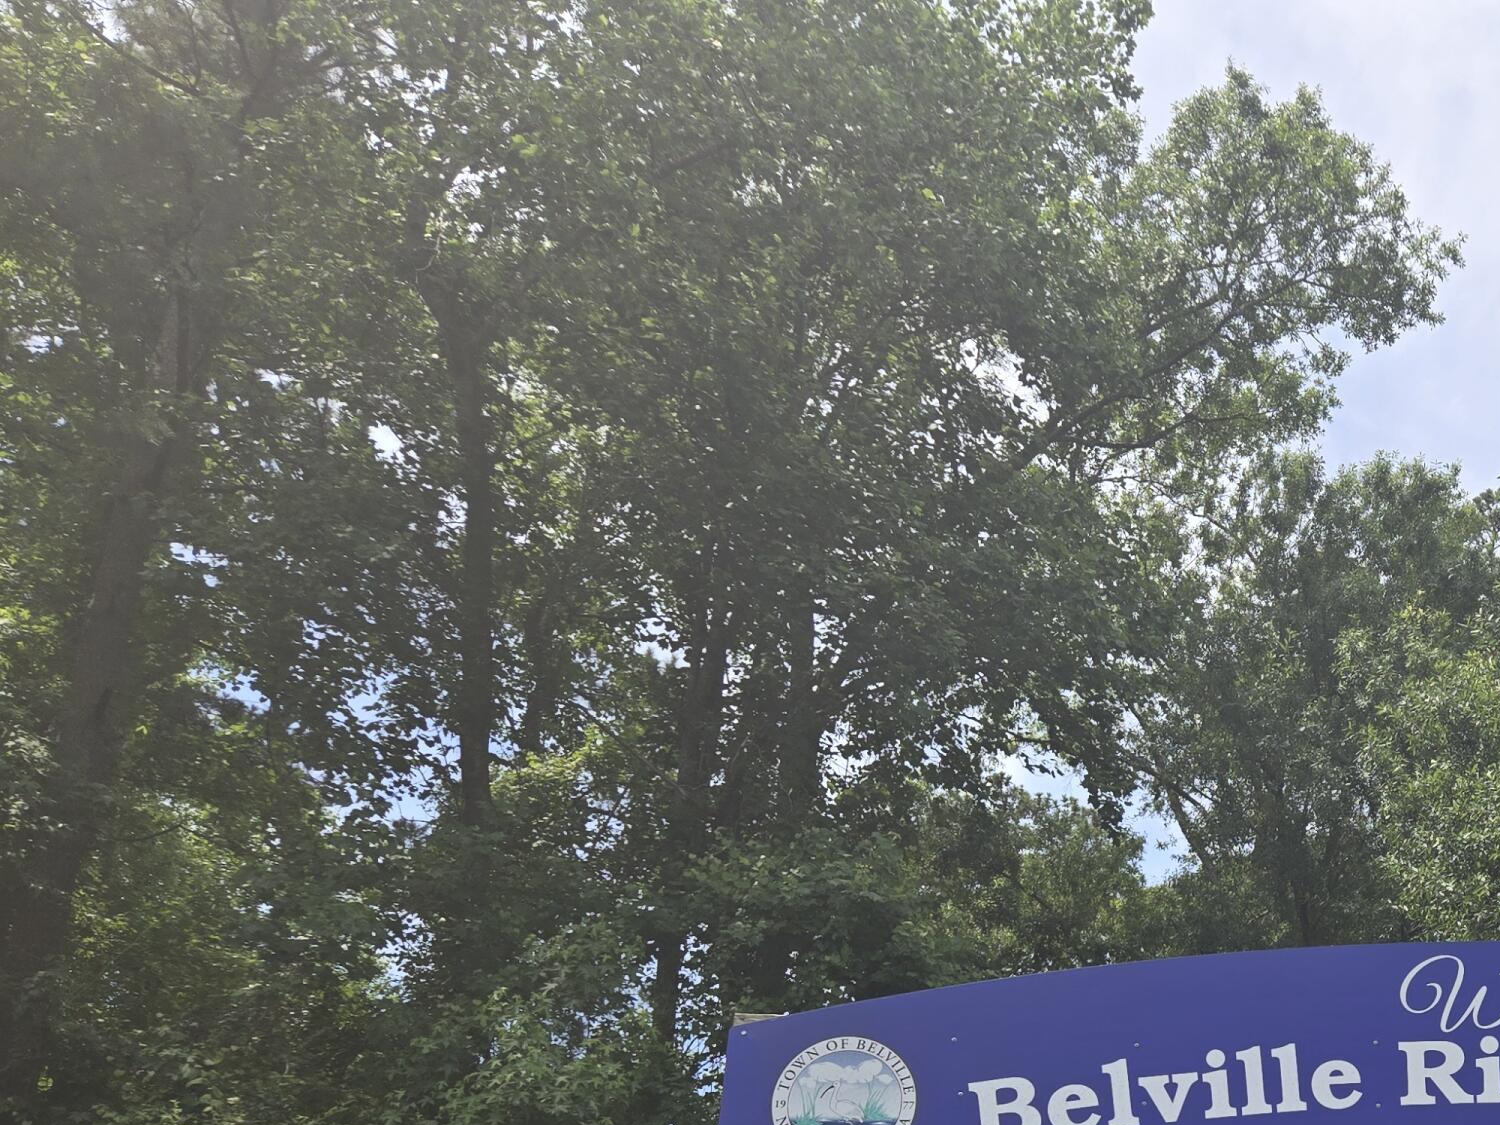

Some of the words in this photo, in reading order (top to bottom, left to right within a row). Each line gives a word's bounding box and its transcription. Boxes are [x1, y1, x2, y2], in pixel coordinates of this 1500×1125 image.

[777, 1047, 819, 1091] TOWN
[825, 1038, 849, 1051] OF
[856, 1039, 915, 1095] BELVILLE
[775, 1100, 786, 1108] 19
